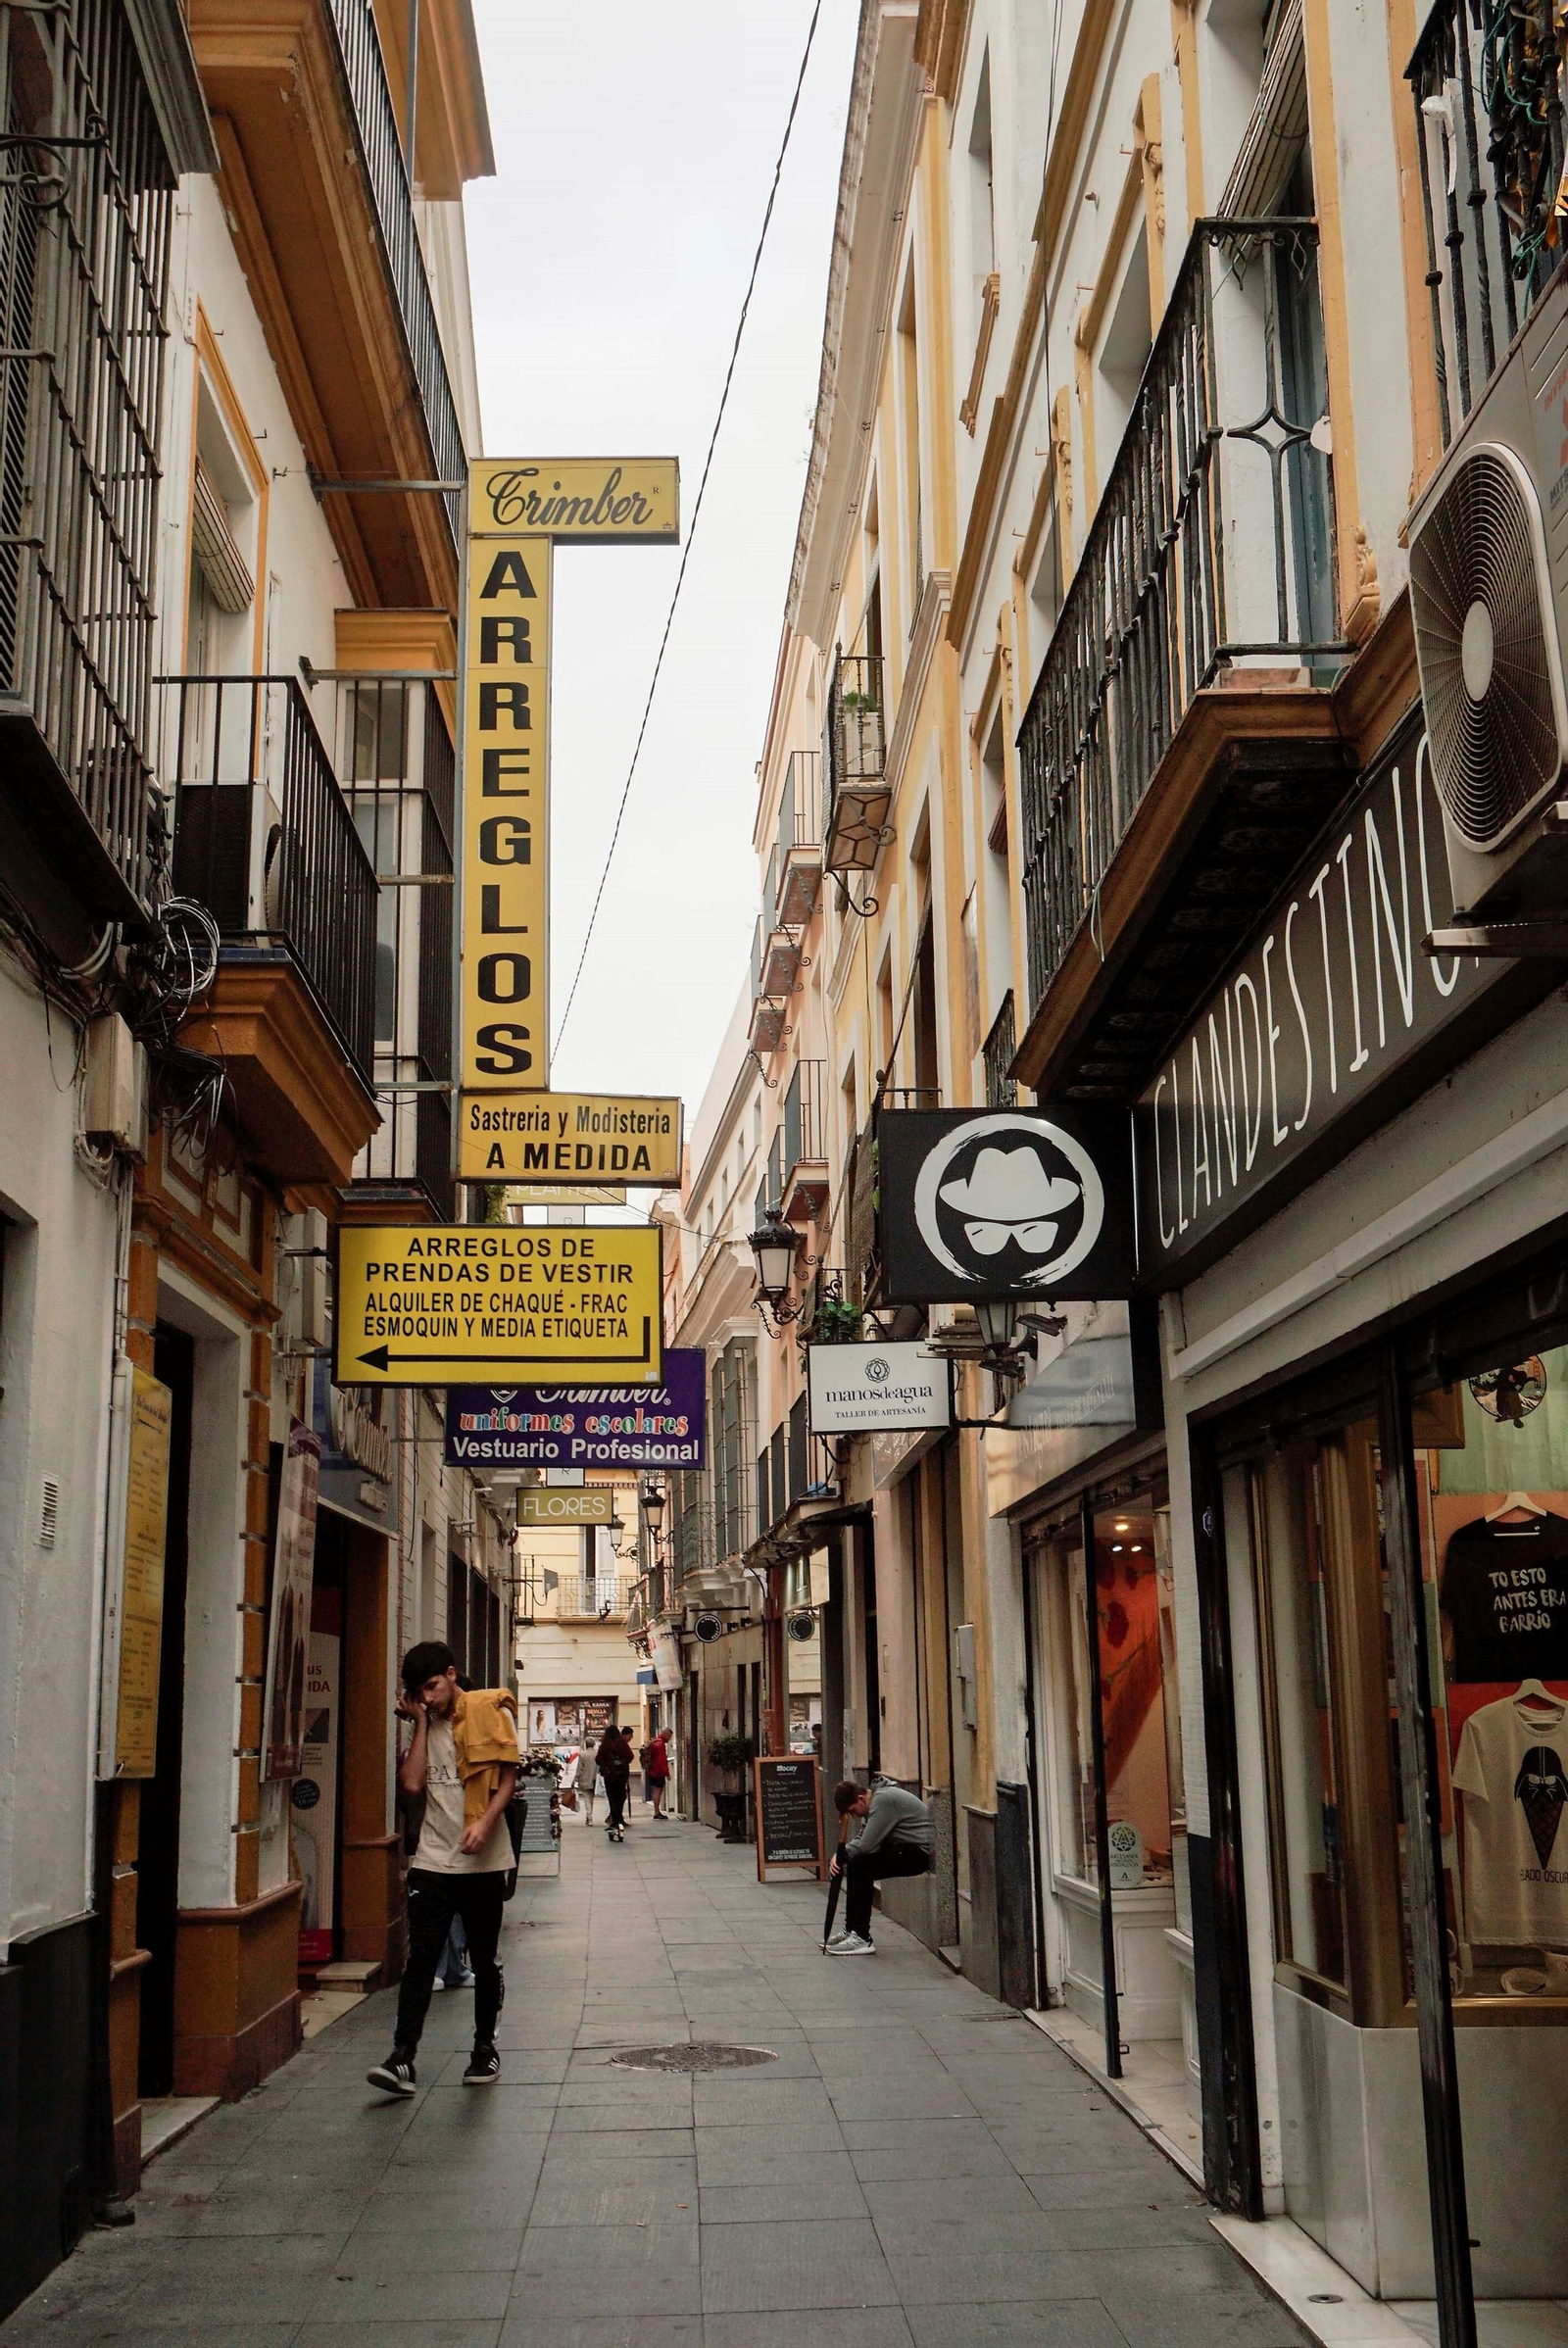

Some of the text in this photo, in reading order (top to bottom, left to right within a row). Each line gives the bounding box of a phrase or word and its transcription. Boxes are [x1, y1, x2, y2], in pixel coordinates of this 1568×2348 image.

[486, 466, 654, 526] Trimber
[475, 551, 537, 1076] ARREGLOS
[470, 1103, 670, 1138] Sastreria y Modisteria
[486, 1143, 652, 1171] A MEDIDA
[407, 1237, 595, 1257] ARREGLOS DE
[366, 1262, 634, 1284] PRENDAS DE VESTIR
[366, 1292, 454, 1314] ALQUILER
[461, 1293, 483, 1312] DE
[489, 1289, 564, 1314] CHAQUÉ
[581, 1294, 628, 1313] FRAC
[364, 1317, 628, 1340] ESMOQUIN Y MEDIA ETIQUETA
[461, 1406, 689, 1437] uniformes escolares
[835, 1410, 866, 1419] TALLER
[453, 1437, 699, 1460] Vestuario Profesional
[523, 1496, 606, 1516] FLORES
[1489, 1568, 1546, 1588] TO ESTO
[1494, 1589, 1566, 1611] ANTES ERA
